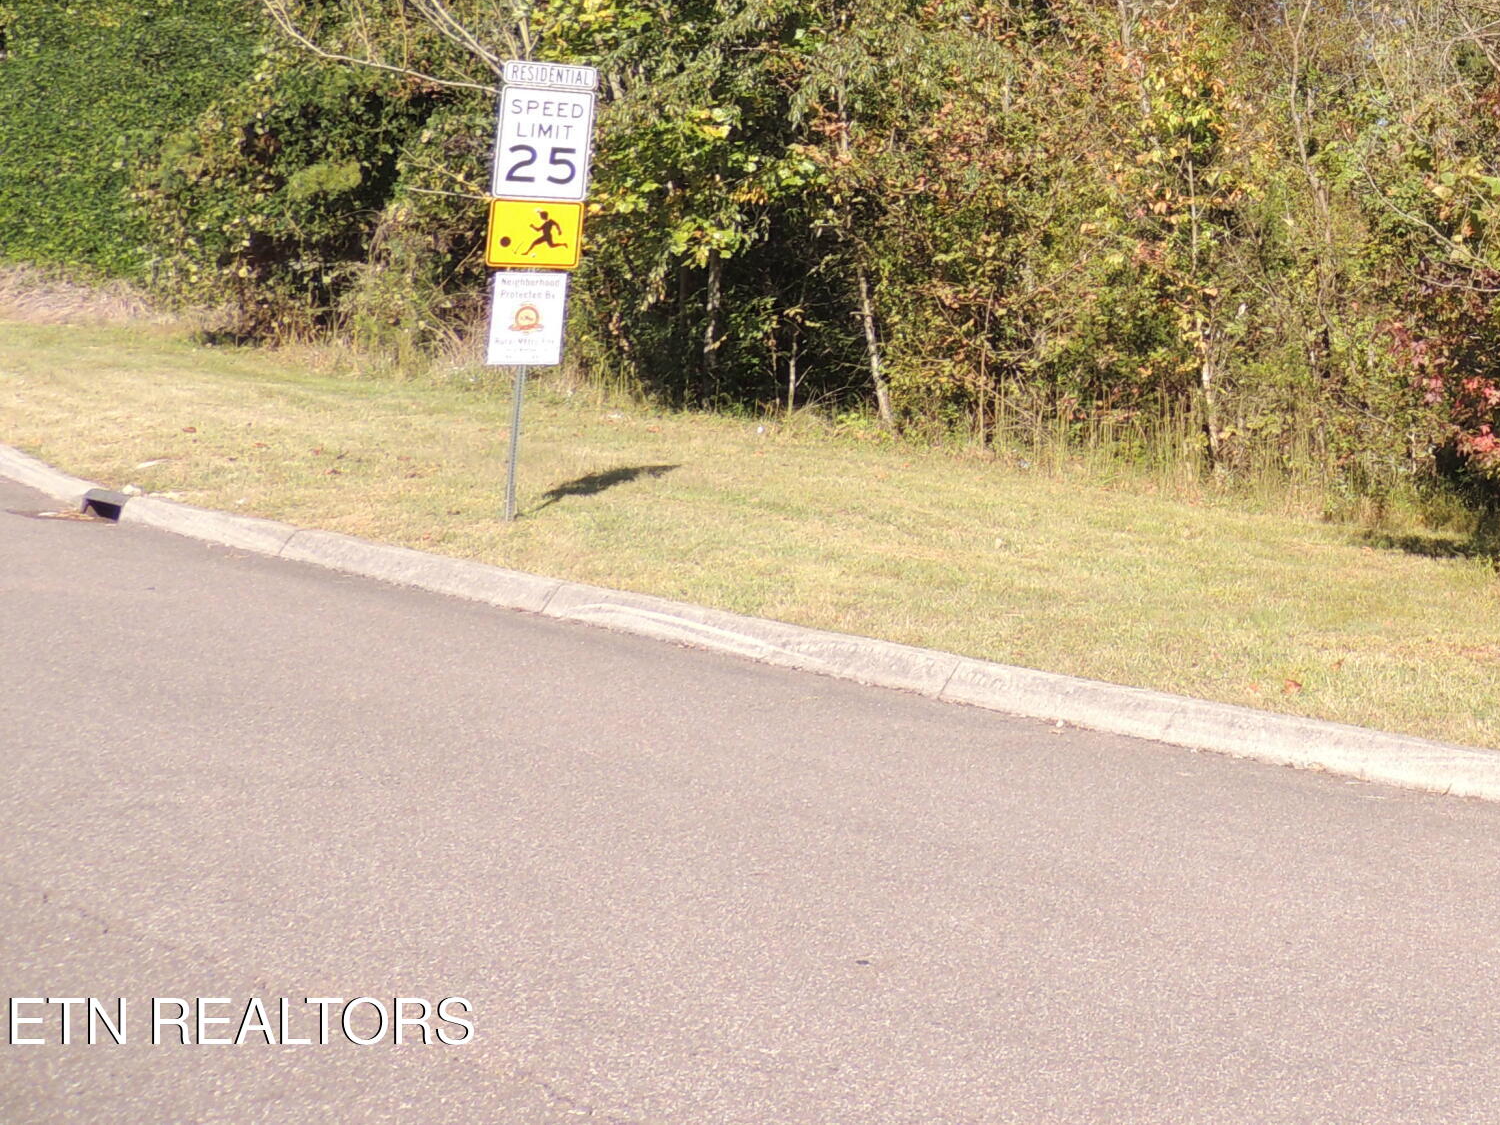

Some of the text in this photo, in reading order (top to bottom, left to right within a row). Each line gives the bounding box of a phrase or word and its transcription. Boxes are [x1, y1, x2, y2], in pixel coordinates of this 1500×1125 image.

[511, 65, 589, 86] RESIDENTIAL
[511, 99, 584, 119] SPEED
[516, 122, 574, 140] LIMIT
[505, 144, 577, 185] 25
